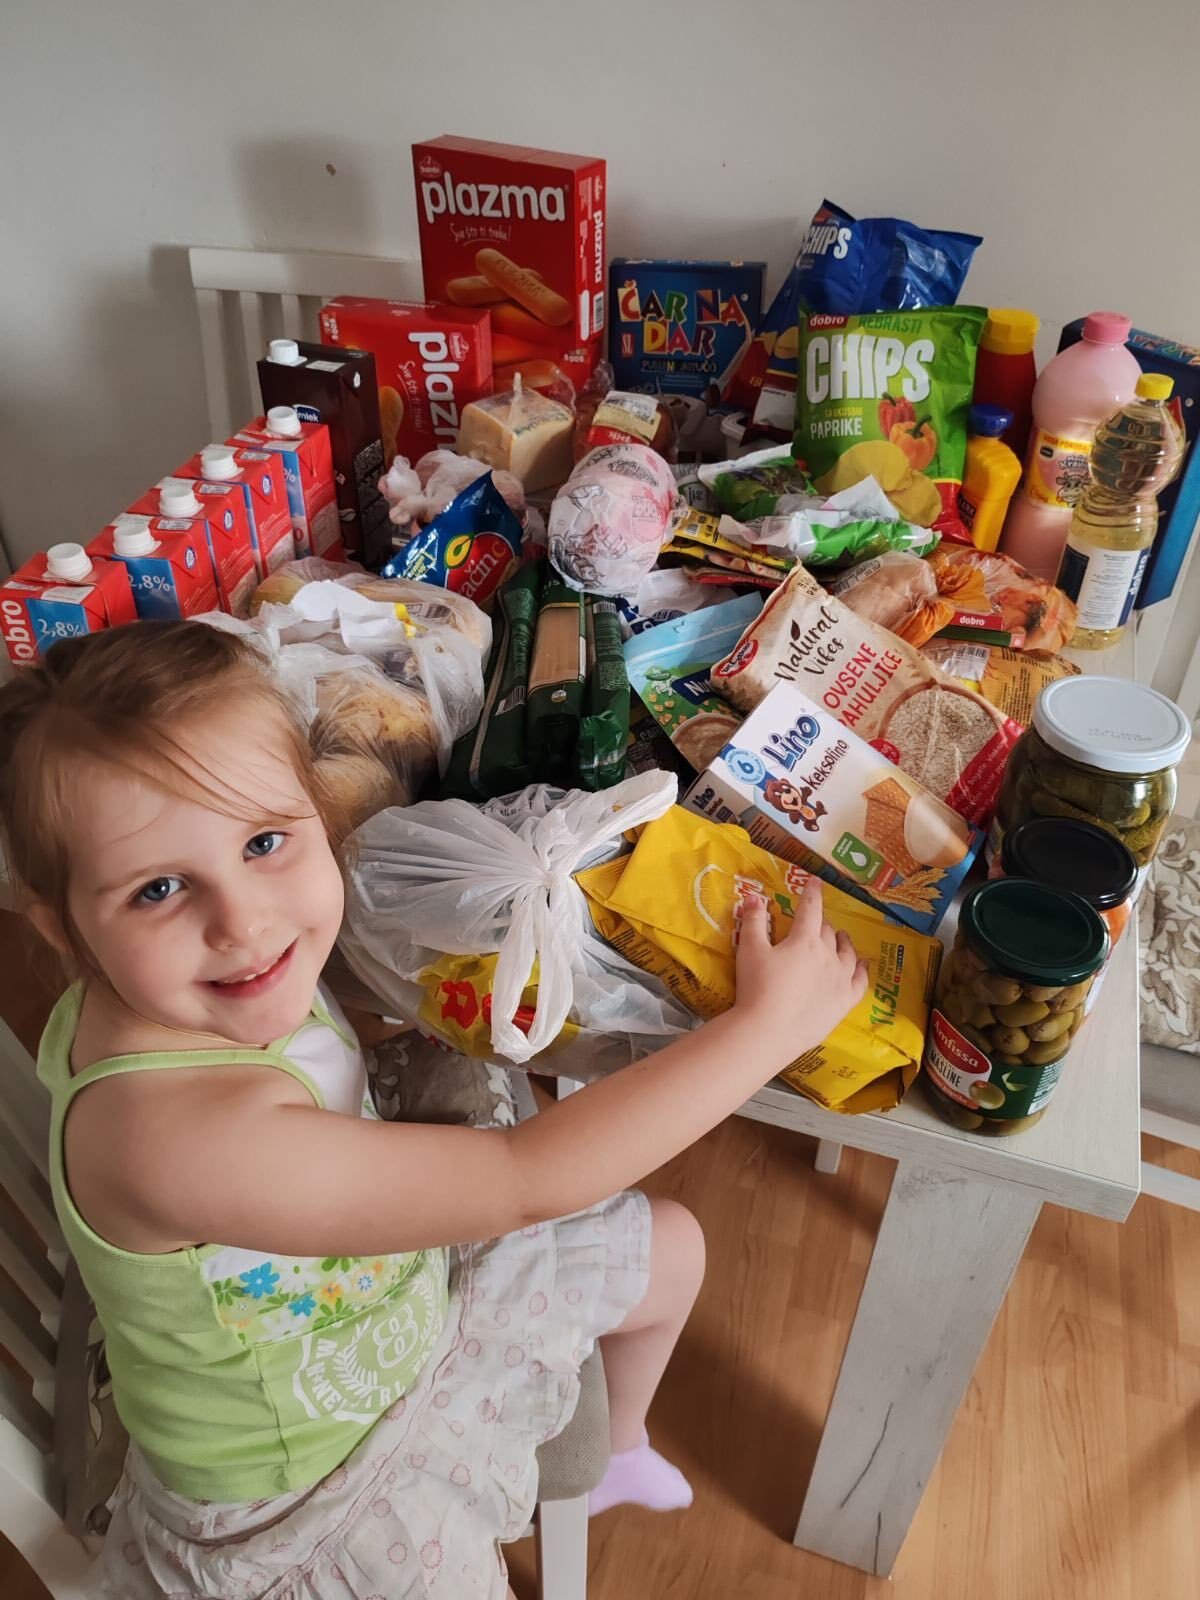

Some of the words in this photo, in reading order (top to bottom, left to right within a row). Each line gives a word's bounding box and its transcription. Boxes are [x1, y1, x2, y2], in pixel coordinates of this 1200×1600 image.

[421, 171, 566, 224] plazma
[593, 209, 604, 284] plazma
[643, 321, 717, 359] DAR
[809, 315, 845, 328] dobro
[857, 314, 923, 334] REBRASTI
[806, 332, 936, 404] CHIPS
[297, 410, 320, 423] mlek
[810, 416, 863, 440] PAPRIKE
[36, 618, 84, 638] 2,8%
[959, 615, 986, 626] dobro
[774, 605, 839, 682] Natural
[804, 637, 844, 675] Vibes
[823, 642, 877, 709] OVSENE
[760, 714, 821, 773] Lino
[736, 759, 754, 775] 6
[800, 738, 850, 791] keksolino
[934, 1020, 979, 1068] Amfissa
[930, 1050, 962, 1088] MASLINE
